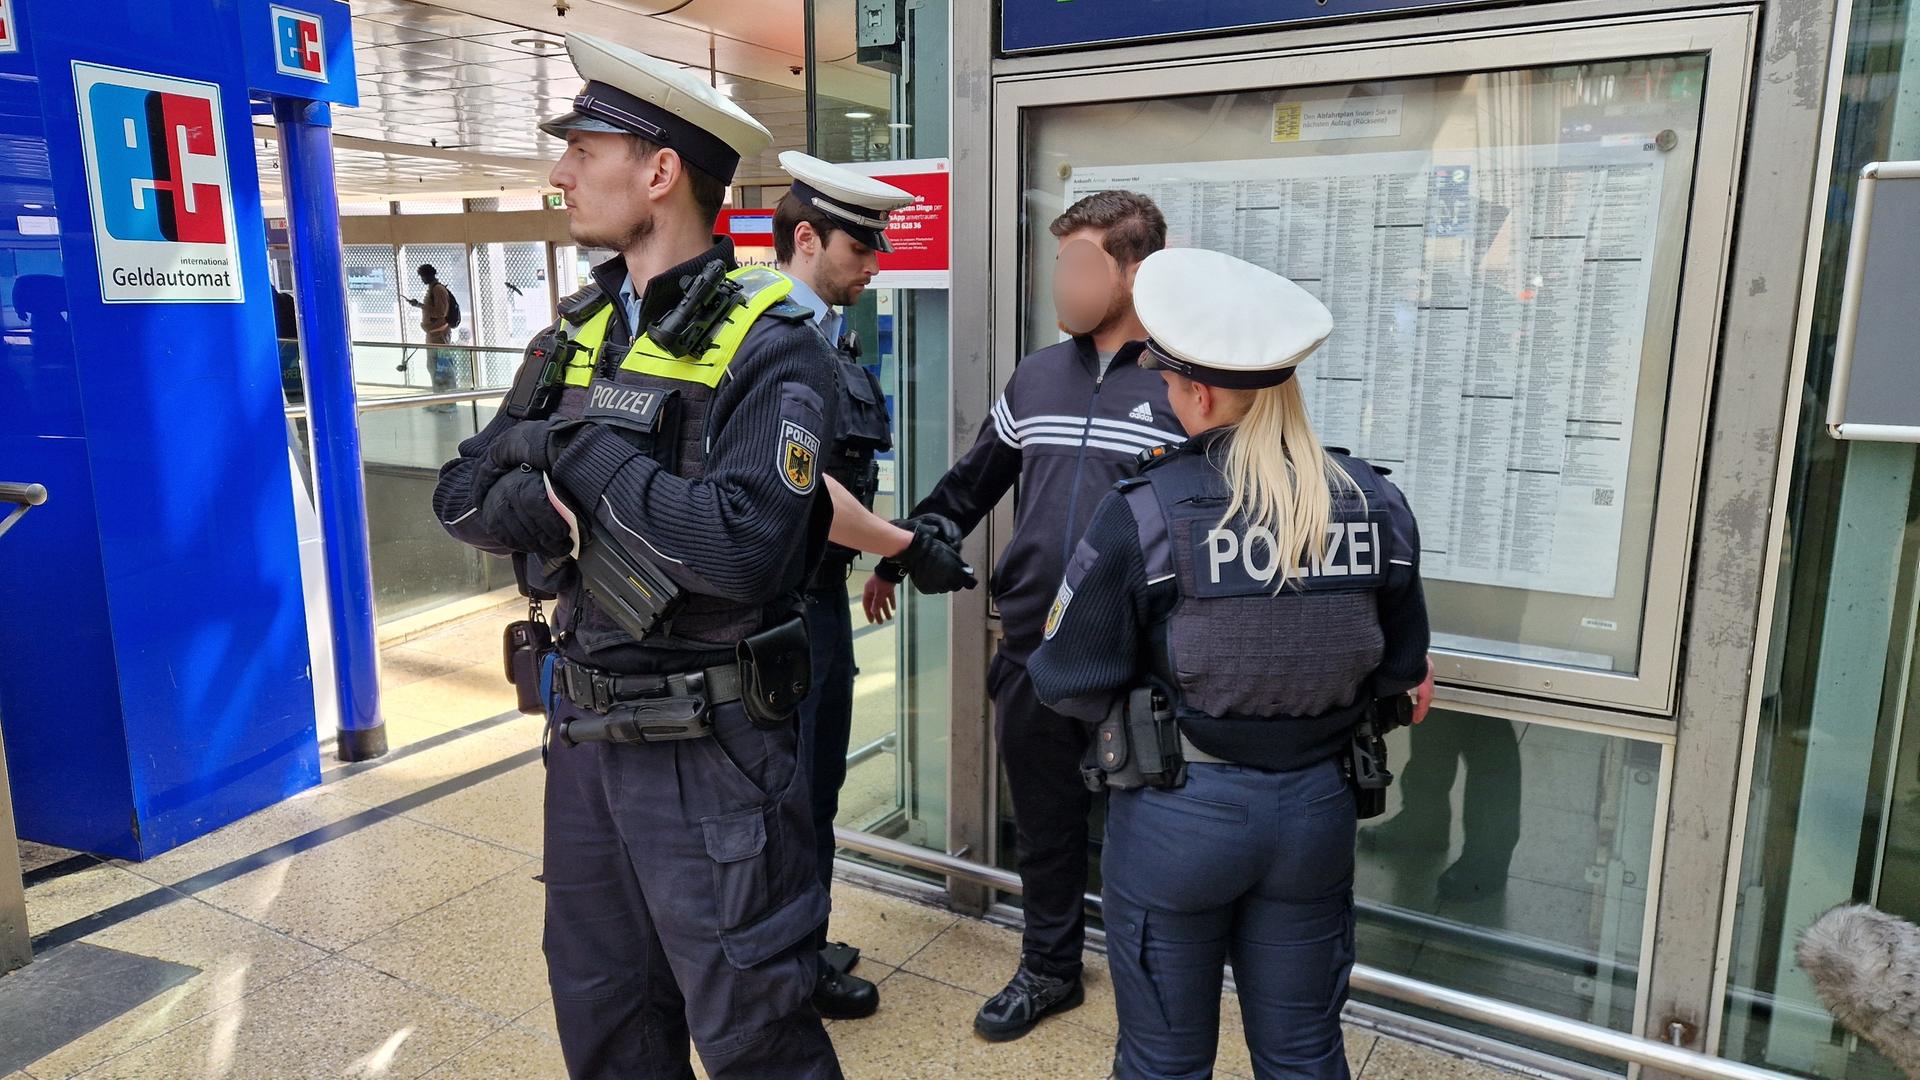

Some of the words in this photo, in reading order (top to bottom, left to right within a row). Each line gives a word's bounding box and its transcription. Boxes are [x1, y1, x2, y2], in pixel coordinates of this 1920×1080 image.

[1316, 110, 1354, 119] Abfahrtplan
[915, 204, 934, 212] Dinge
[180, 256, 229, 266] international
[111, 267, 231, 287] Geldautomat
[589, 384, 654, 416] POLIZEI
[1128, 411, 1154, 423] adidas
[785, 425, 818, 455] POLIZEI
